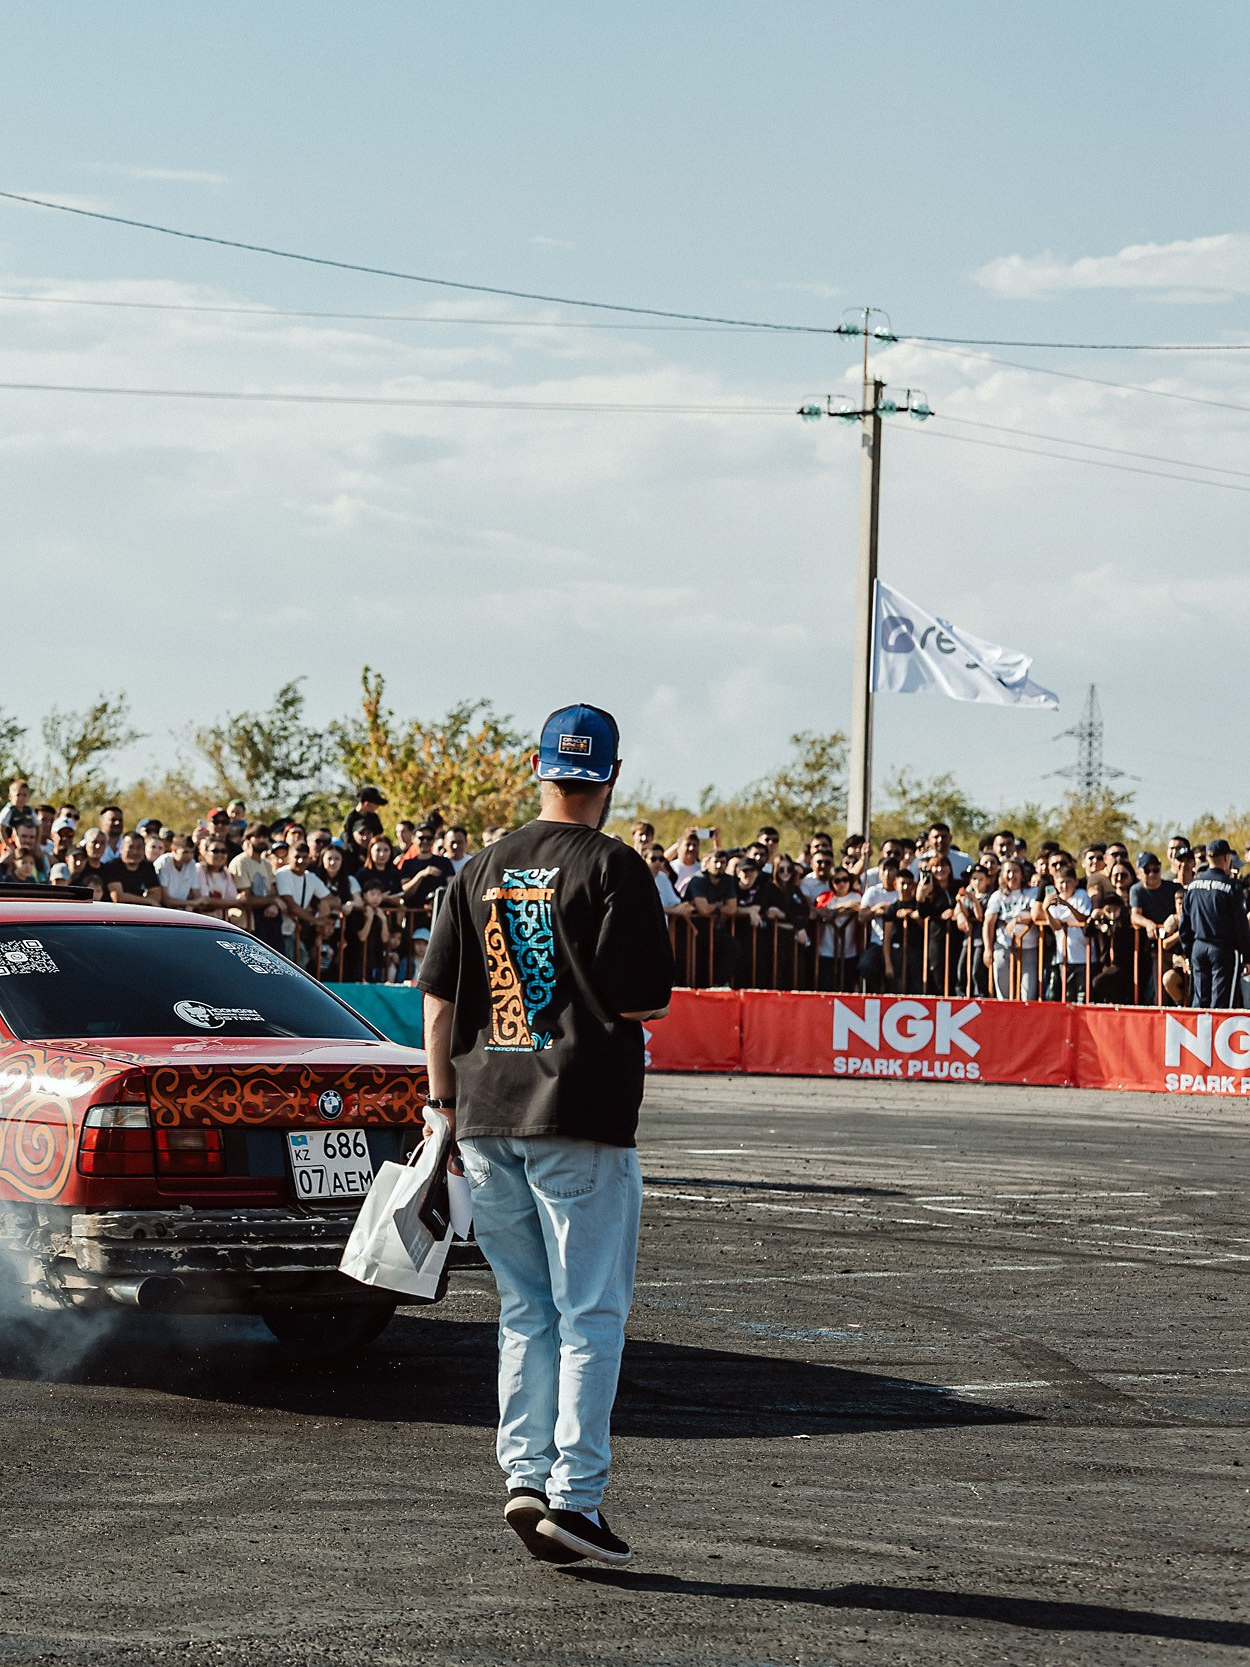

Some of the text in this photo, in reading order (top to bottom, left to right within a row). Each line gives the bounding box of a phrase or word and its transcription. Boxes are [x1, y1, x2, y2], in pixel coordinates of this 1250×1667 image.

[833, 998, 982, 1058] NGK
[833, 1057, 980, 1079] SPARK PLUGS
[1165, 1073, 1235, 1093] SPARK
[294, 1149, 311, 1161] KZ
[323, 1132, 366, 1159] 686
[299, 1169, 372, 1194] 07 AEM
